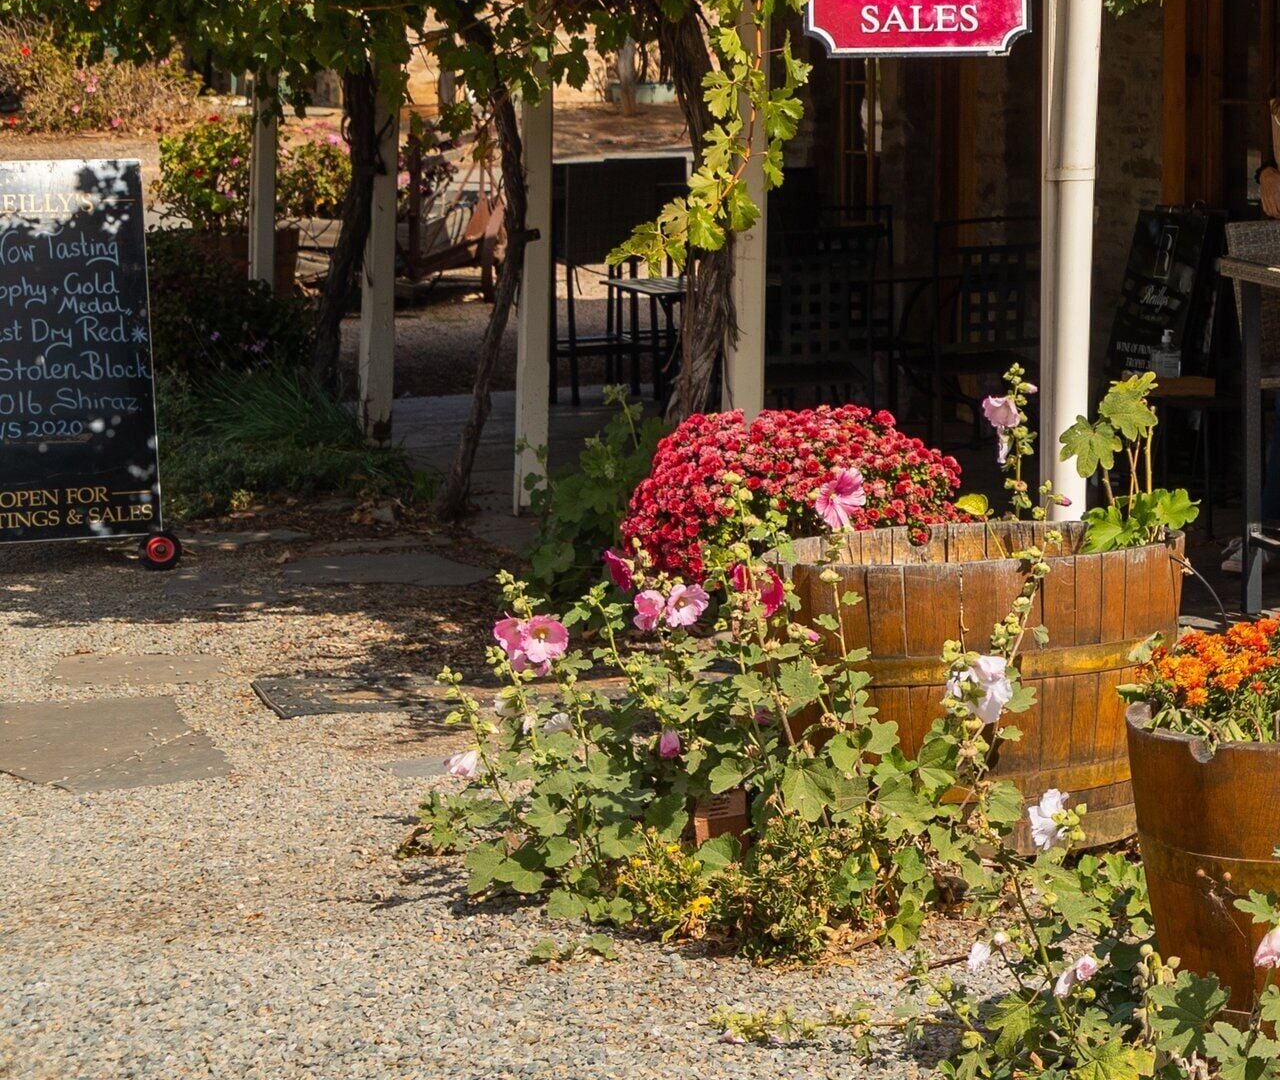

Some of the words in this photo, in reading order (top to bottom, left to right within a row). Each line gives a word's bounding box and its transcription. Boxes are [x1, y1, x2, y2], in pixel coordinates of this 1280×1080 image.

[860, 4, 979, 34] SALES
[0, 192, 94, 214] EILLY'S
[35, 226, 119, 266] Tasting
[64, 271, 120, 295] Gold
[0, 320, 23, 341] st
[32, 318, 73, 358] Dry
[75, 315, 129, 342] Red
[0, 355, 81, 381] Stolen
[80, 351, 152, 380] Block
[26, 420, 83, 437] 2020
[0, 489, 59, 508] OPEN
[65, 486, 110, 505] FOR
[66, 509, 84, 525] &
[88, 504, 153, 524] SALES
